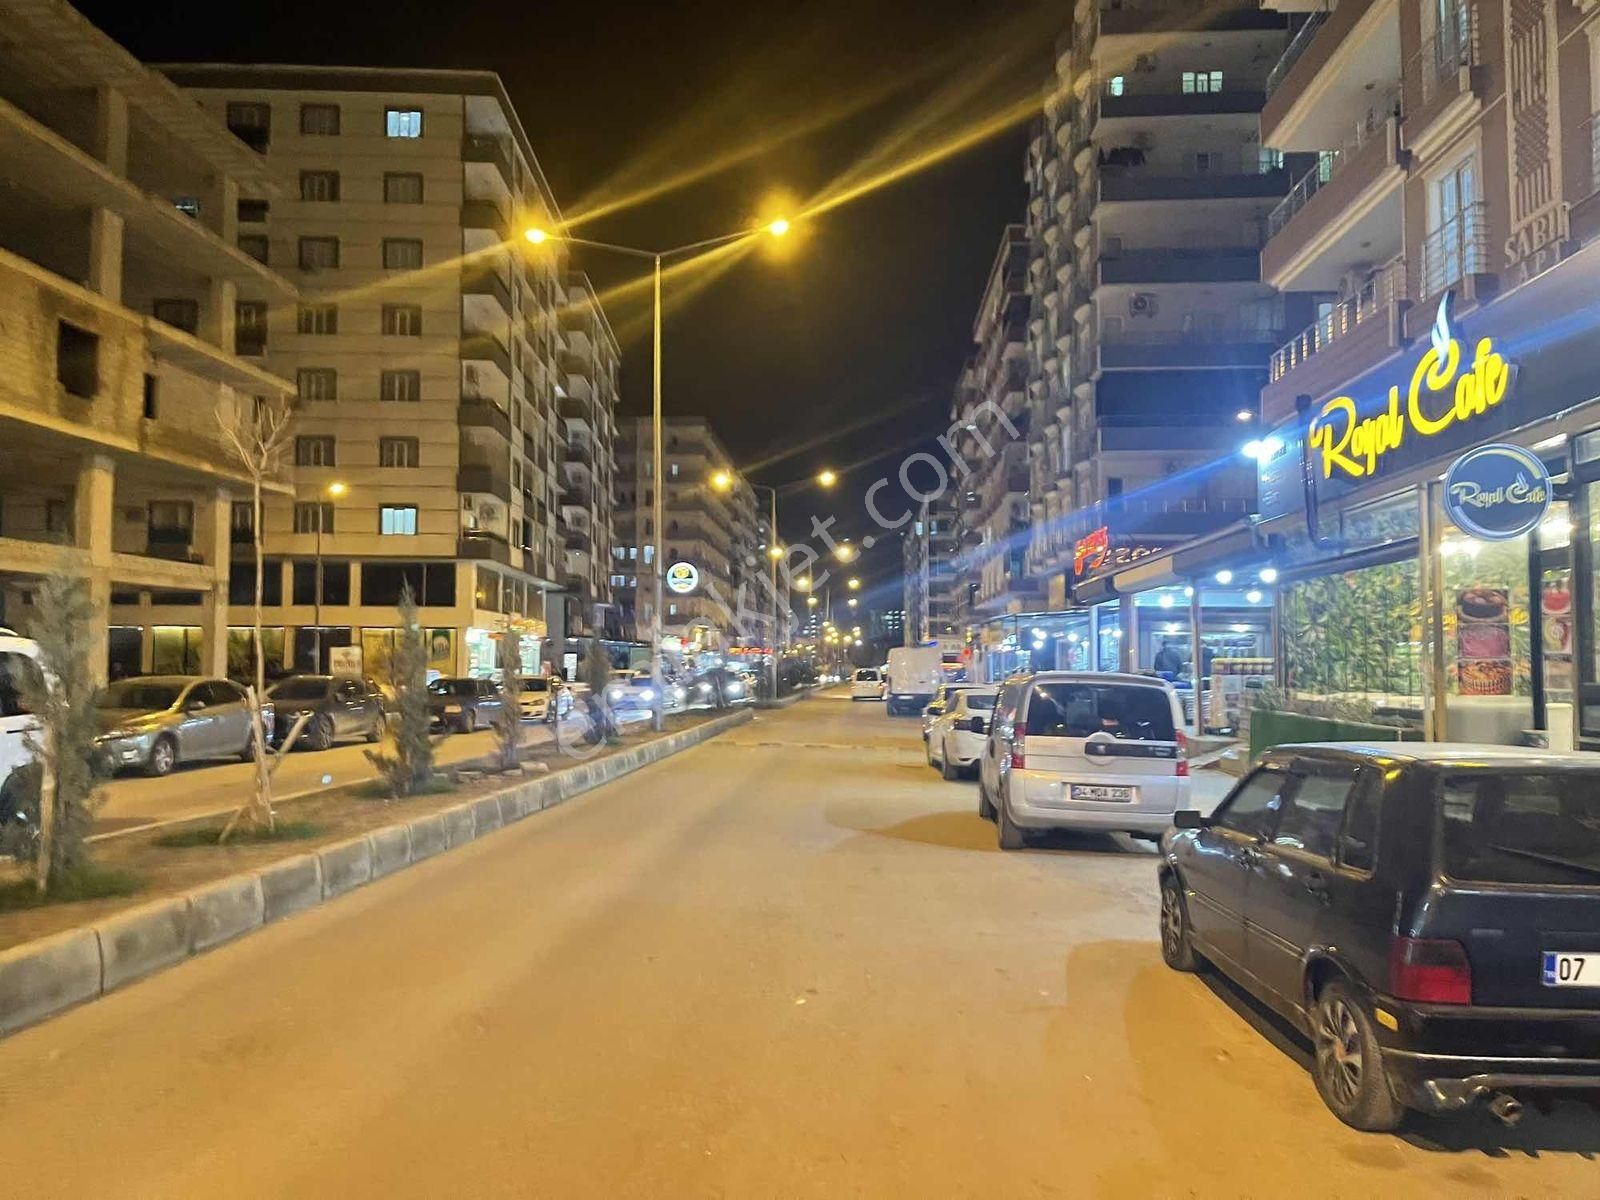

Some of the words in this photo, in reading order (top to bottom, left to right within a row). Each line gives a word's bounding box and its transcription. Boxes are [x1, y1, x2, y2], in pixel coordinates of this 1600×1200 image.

[1309, 385, 1405, 479] Royal
[1408, 337, 1510, 435] Cafe
[1449, 481, 1506, 508] Royal
[1559, 958, 1586, 981] 07
